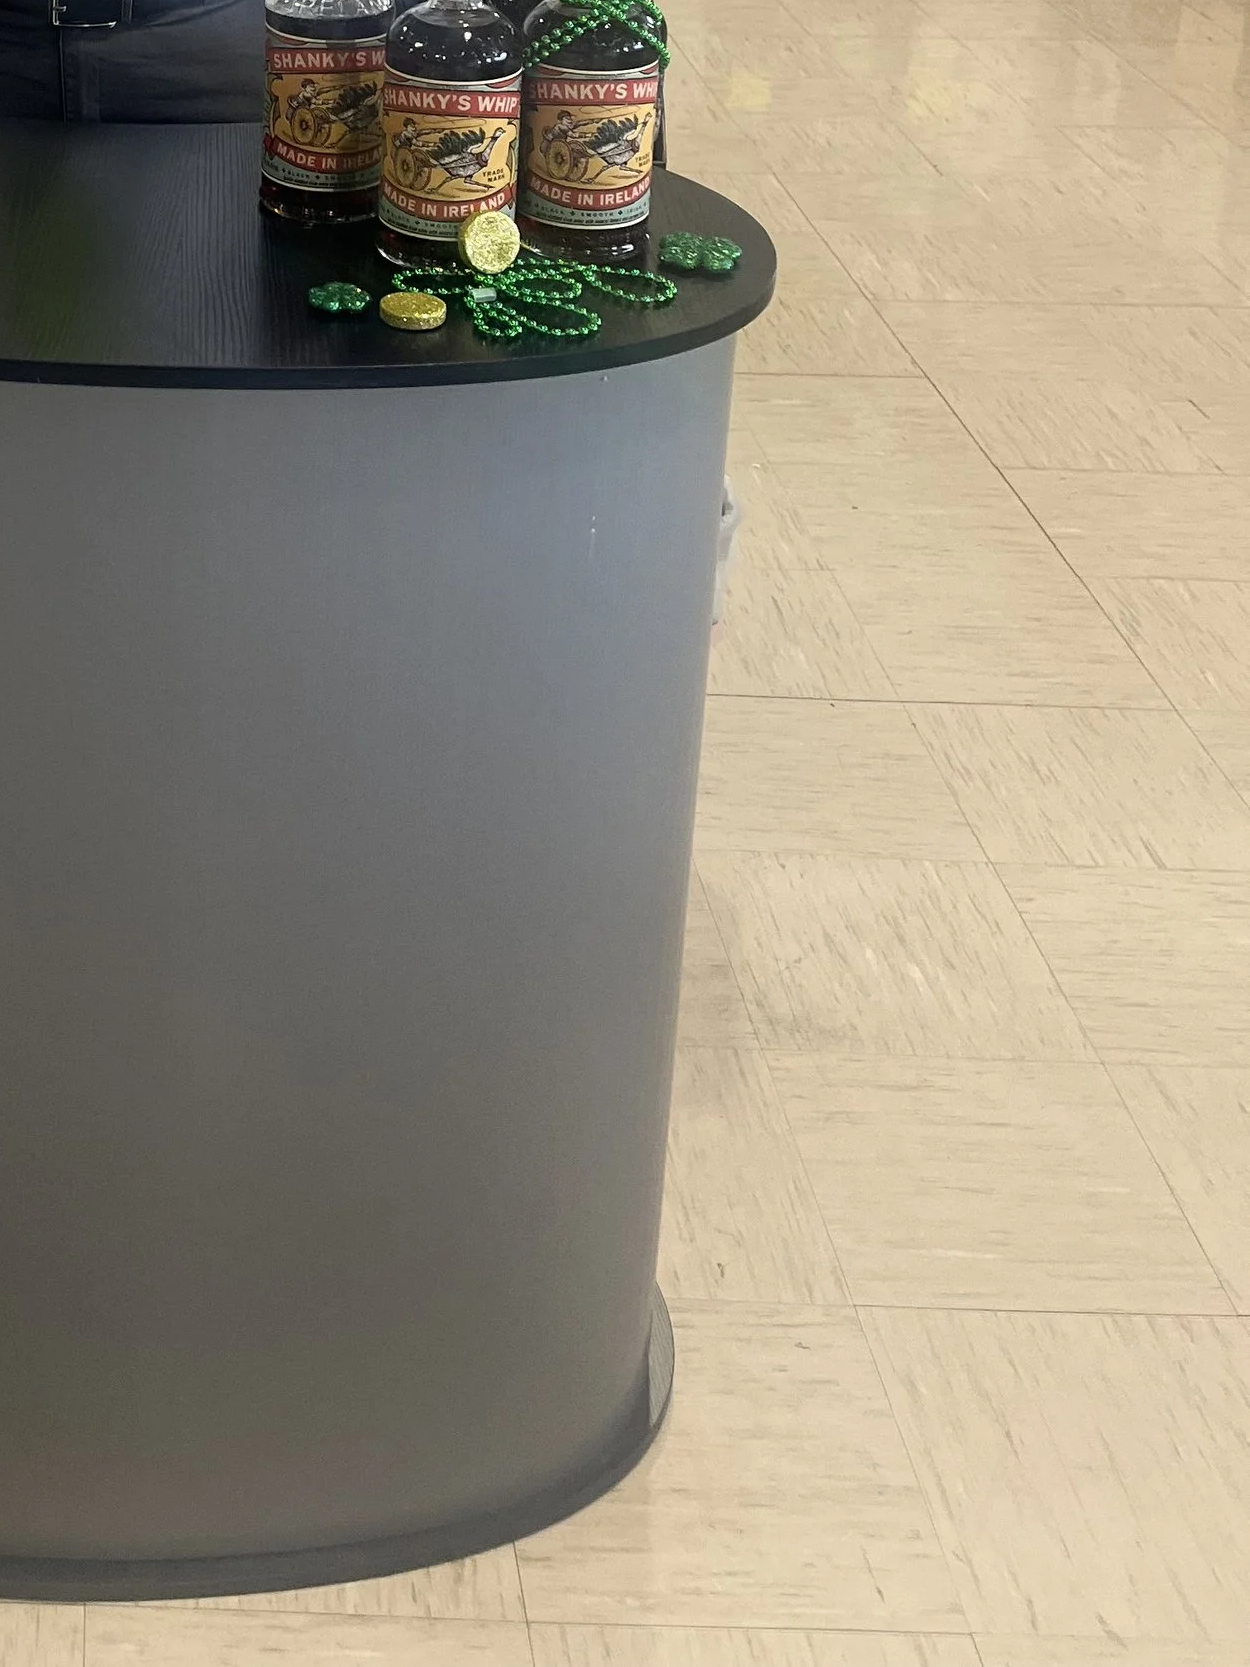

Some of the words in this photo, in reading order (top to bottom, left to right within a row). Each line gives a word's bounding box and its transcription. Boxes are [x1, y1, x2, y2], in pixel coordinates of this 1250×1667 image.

[273, 51, 367, 70] SHANKY'S
[384, 88, 471, 112] SHANKY'S
[477, 96, 518, 113] WHIP
[529, 83, 627, 100] SHANKY'S
[277, 144, 316, 167] MADE
[322, 157, 337, 169] IN
[482, 167, 504, 178] TRADE
[487, 174, 506, 183] MARK
[384, 183, 416, 212] MADE
[421, 202, 438, 217] IN
[529, 176, 571, 203] MADE
[577, 193, 594, 206] IN
[599, 178, 650, 206] IRELAND
